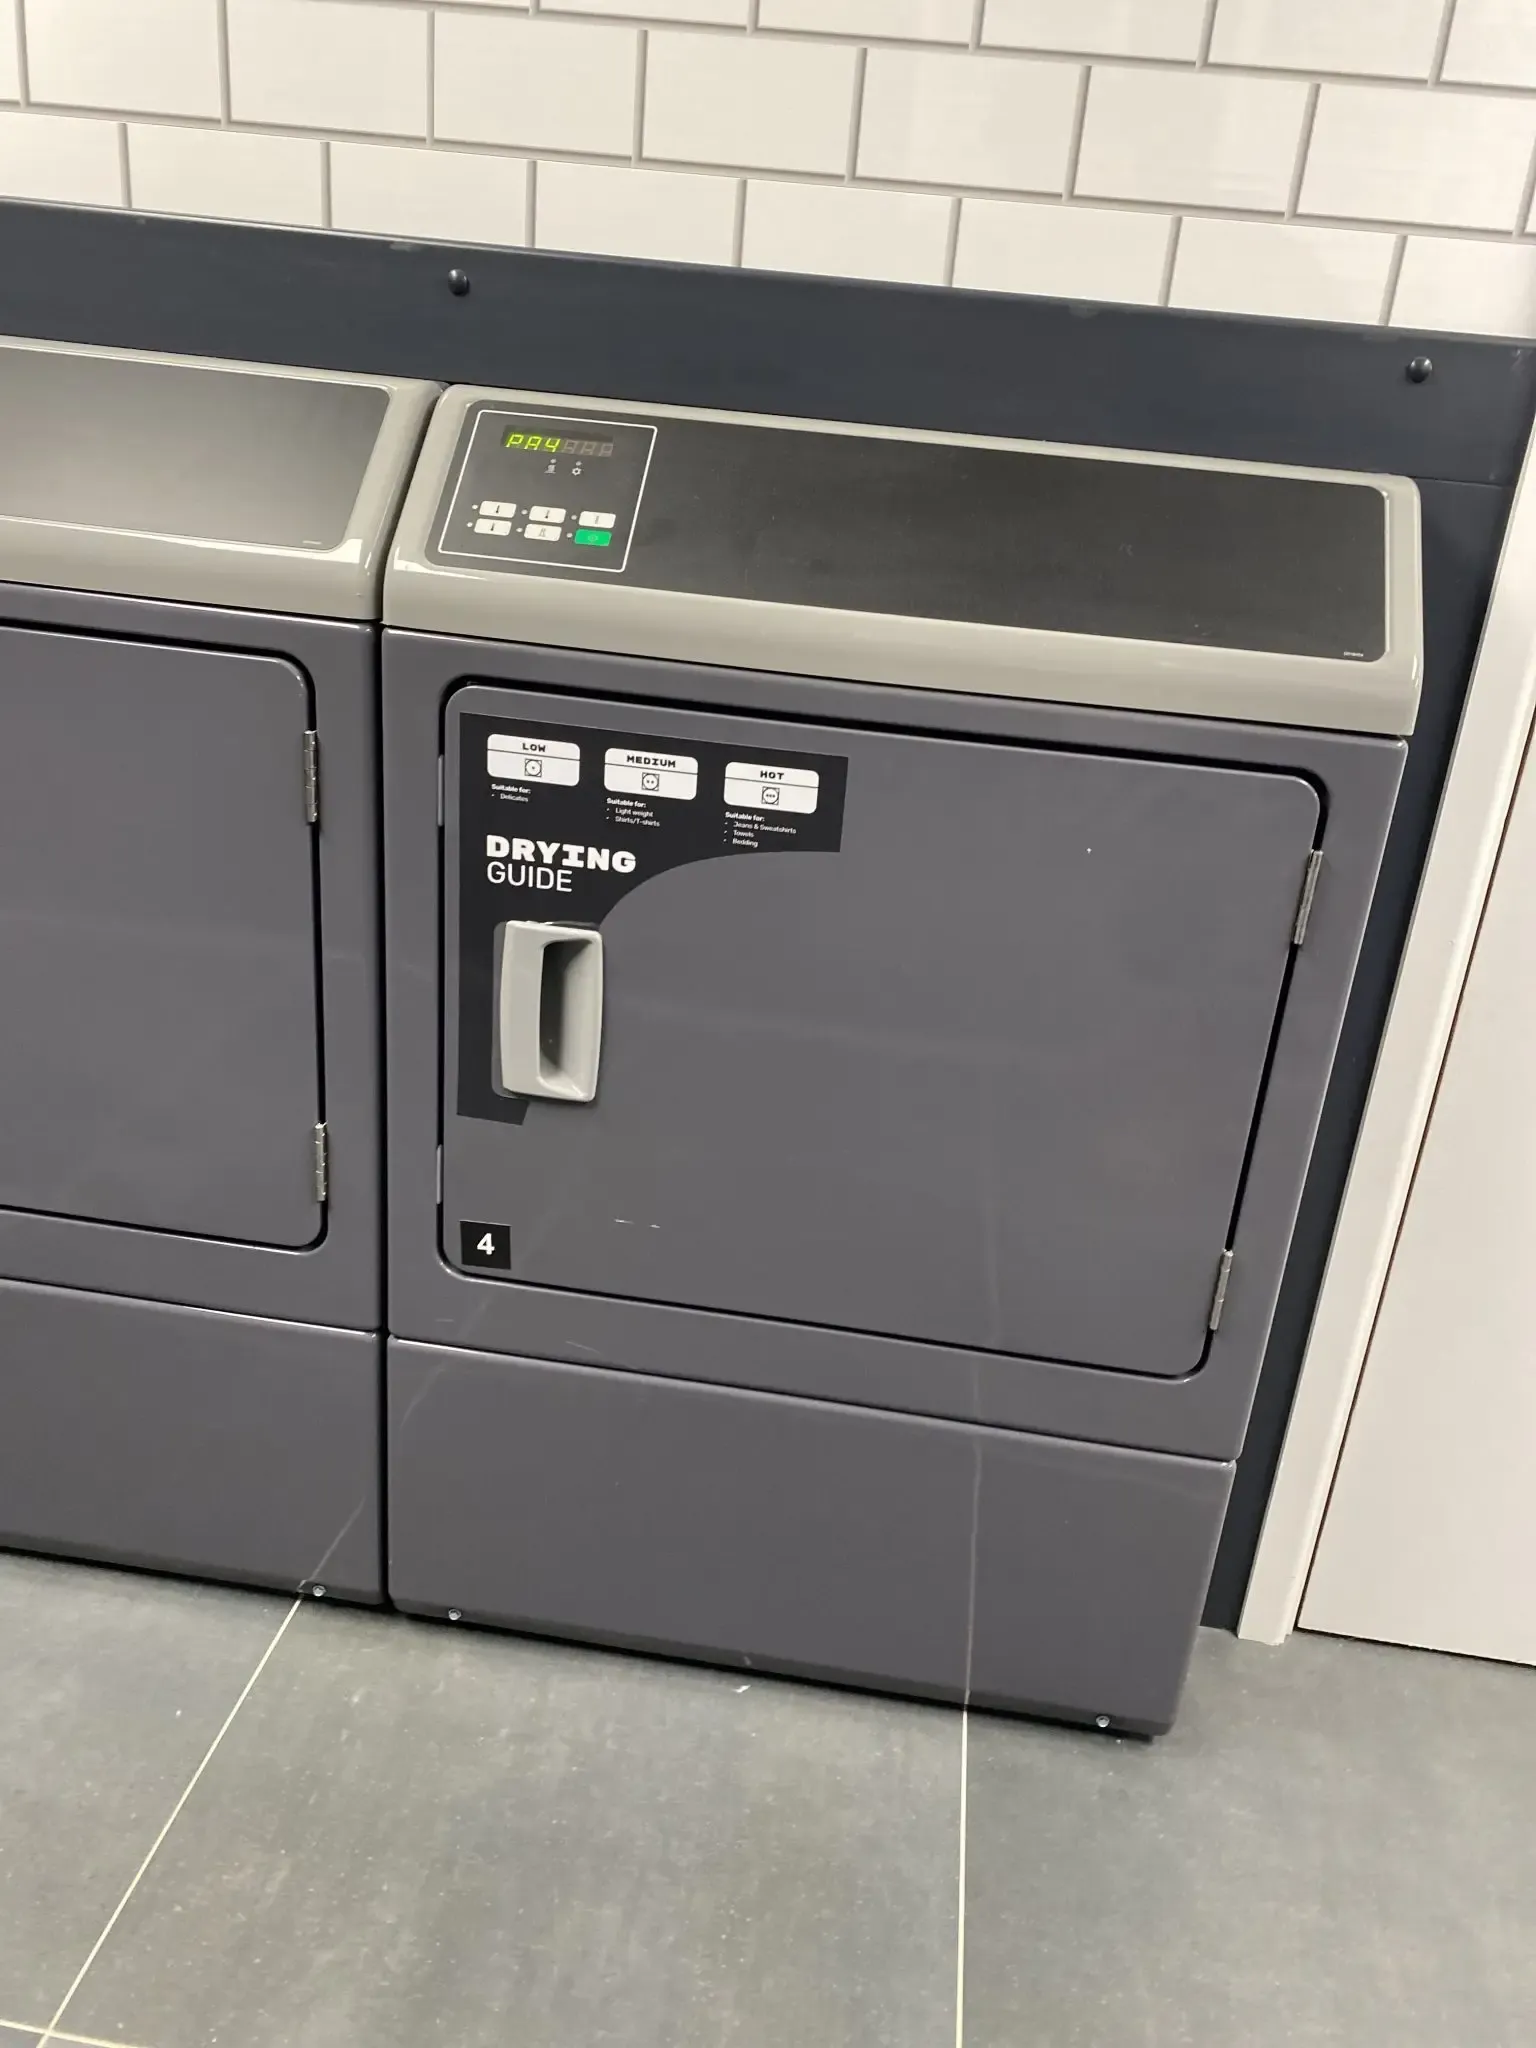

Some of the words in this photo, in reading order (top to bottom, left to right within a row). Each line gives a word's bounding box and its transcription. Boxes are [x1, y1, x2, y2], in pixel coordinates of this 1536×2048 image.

[522, 743, 546, 753] LOW
[626, 755, 676, 767] MEDIUM
[760, 770, 785, 780] HOT
[491, 783, 518, 792] Suitable
[519, 786, 531, 794] for:
[500, 793, 529, 802] Delicates
[606, 797, 633, 807] Suitable
[634, 800, 647, 808] for:
[615, 807, 631, 816] Light
[632, 810, 653, 818] weight
[725, 811, 752, 821] Suitable
[753, 814, 765, 822] for:
[615, 816, 660, 827] Shirts/T-shirts
[733, 821, 753, 830] Jeans
[759, 824, 797, 835] Sweatshirts
[733, 830, 755, 838] Towels
[732, 838, 759, 848] Bedding
[486, 835, 637, 874] DRYING
[487, 861, 573, 893] GUIDE
[476, 1232, 495, 1255] 4
